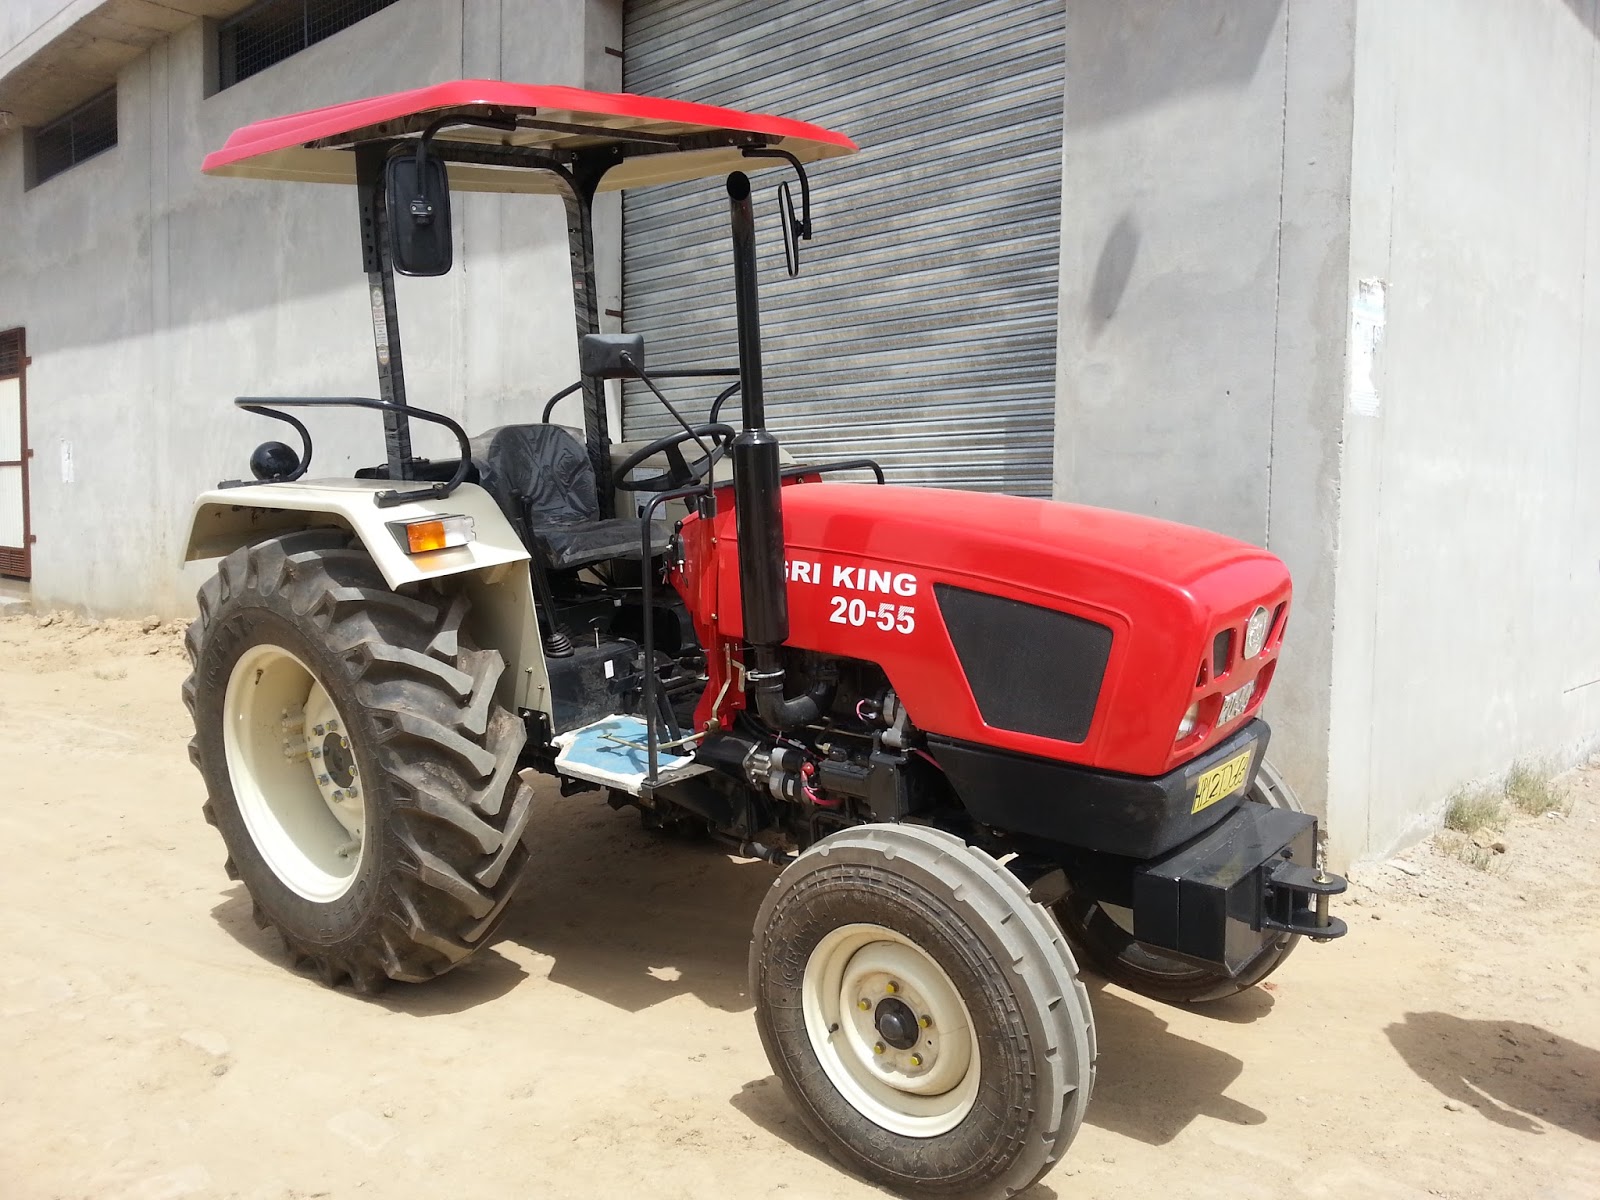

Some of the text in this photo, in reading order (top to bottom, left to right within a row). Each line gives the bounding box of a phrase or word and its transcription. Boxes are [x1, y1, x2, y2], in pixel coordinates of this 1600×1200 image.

[784, 561, 917, 596] RI KING
[830, 596, 915, 634] 20-55
[781, 919, 819, 982] CEAT
